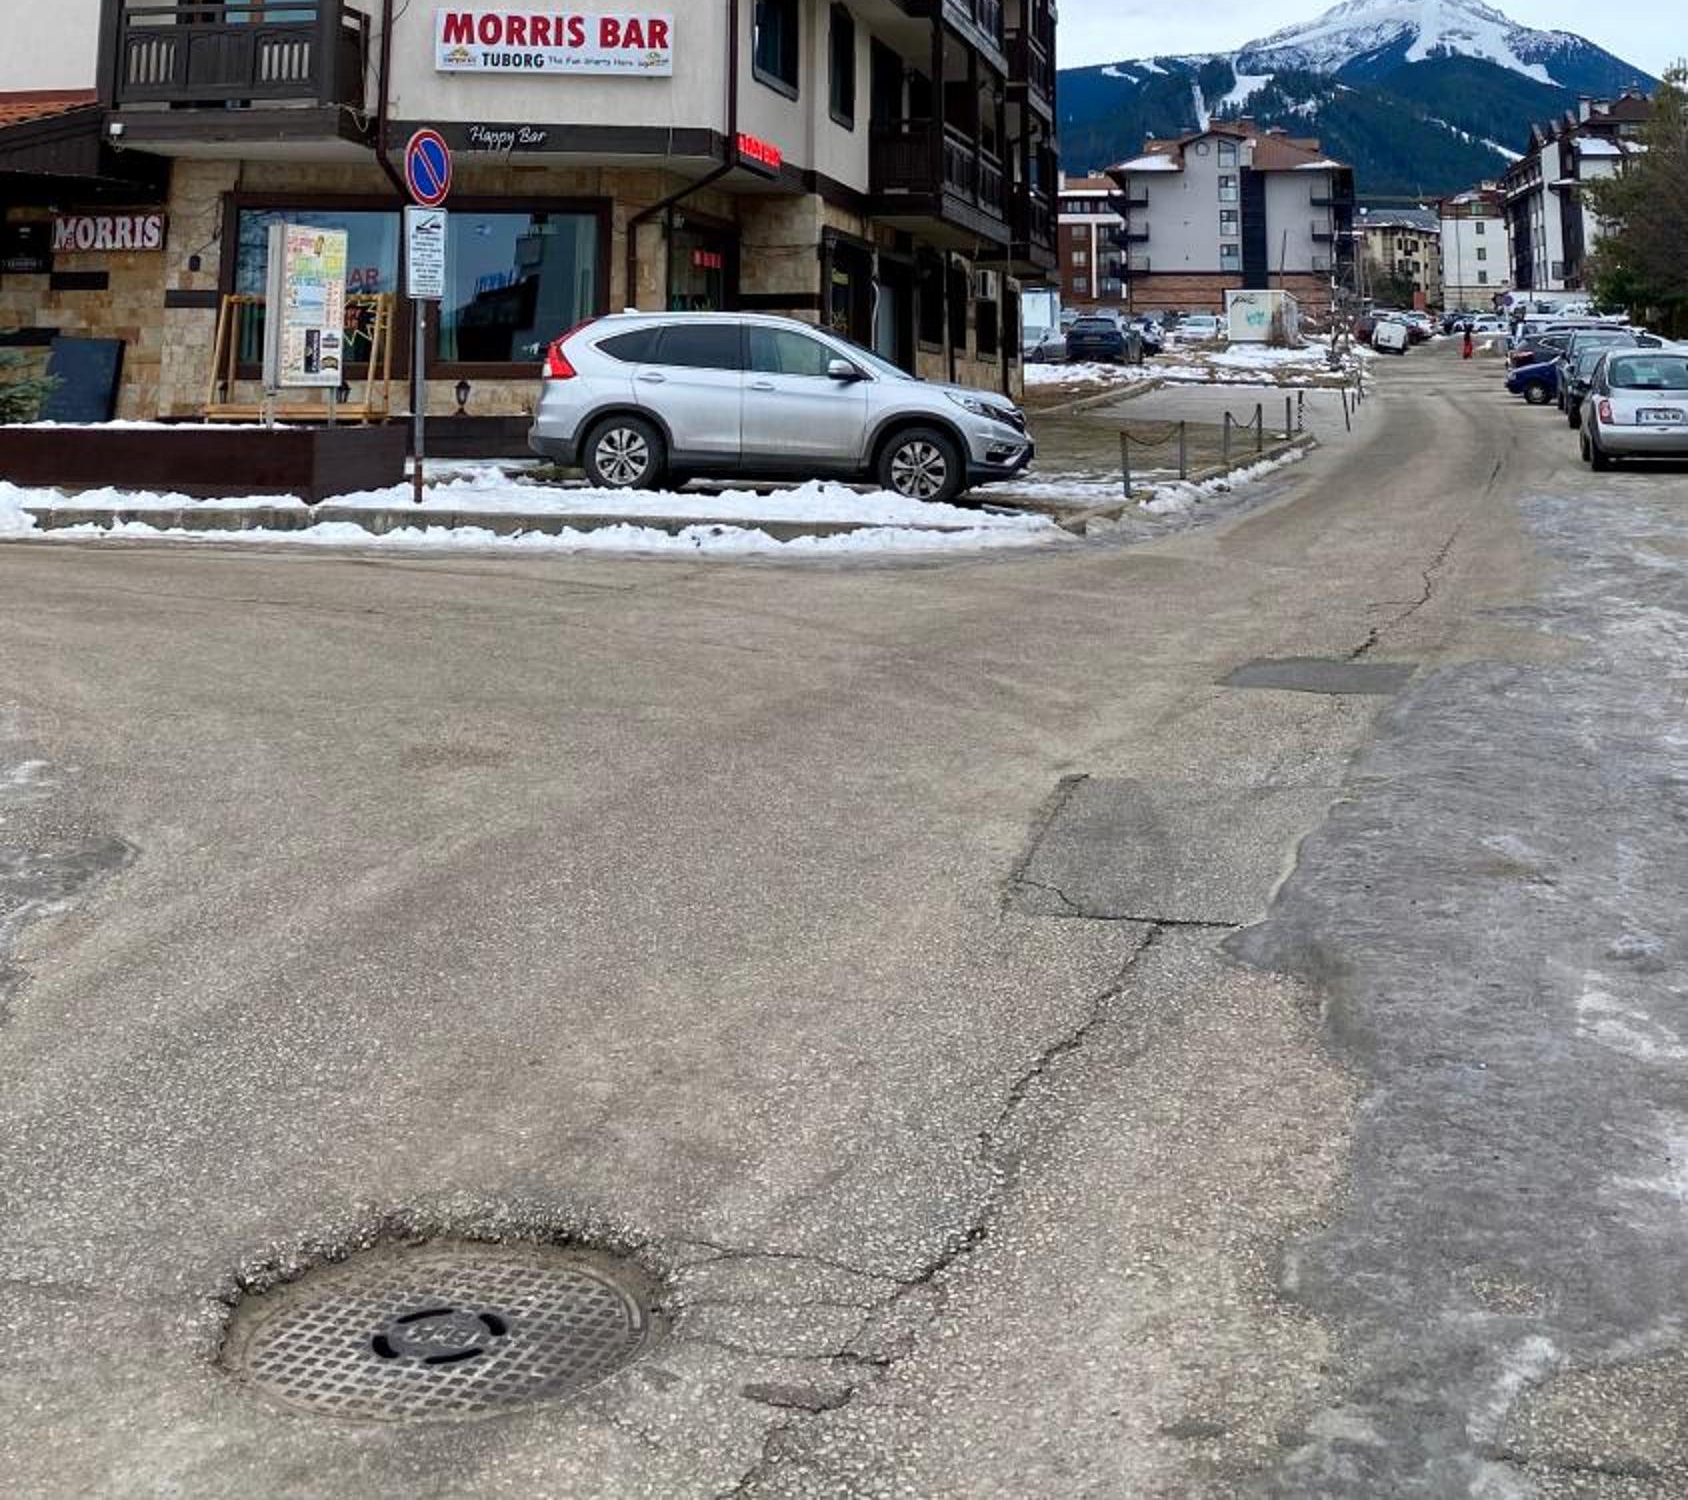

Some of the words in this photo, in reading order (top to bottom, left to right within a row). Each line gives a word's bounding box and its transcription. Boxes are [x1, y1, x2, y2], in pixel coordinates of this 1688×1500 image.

[443, 13, 585, 48] MORRIS
[599, 17, 669, 49] BAR
[482, 52, 545, 68] TUBORG
[469, 125, 515, 152] Happy
[518, 125, 547, 143] Bar
[53, 215, 162, 249] MORRIS
[349, 266, 380, 285] AR
